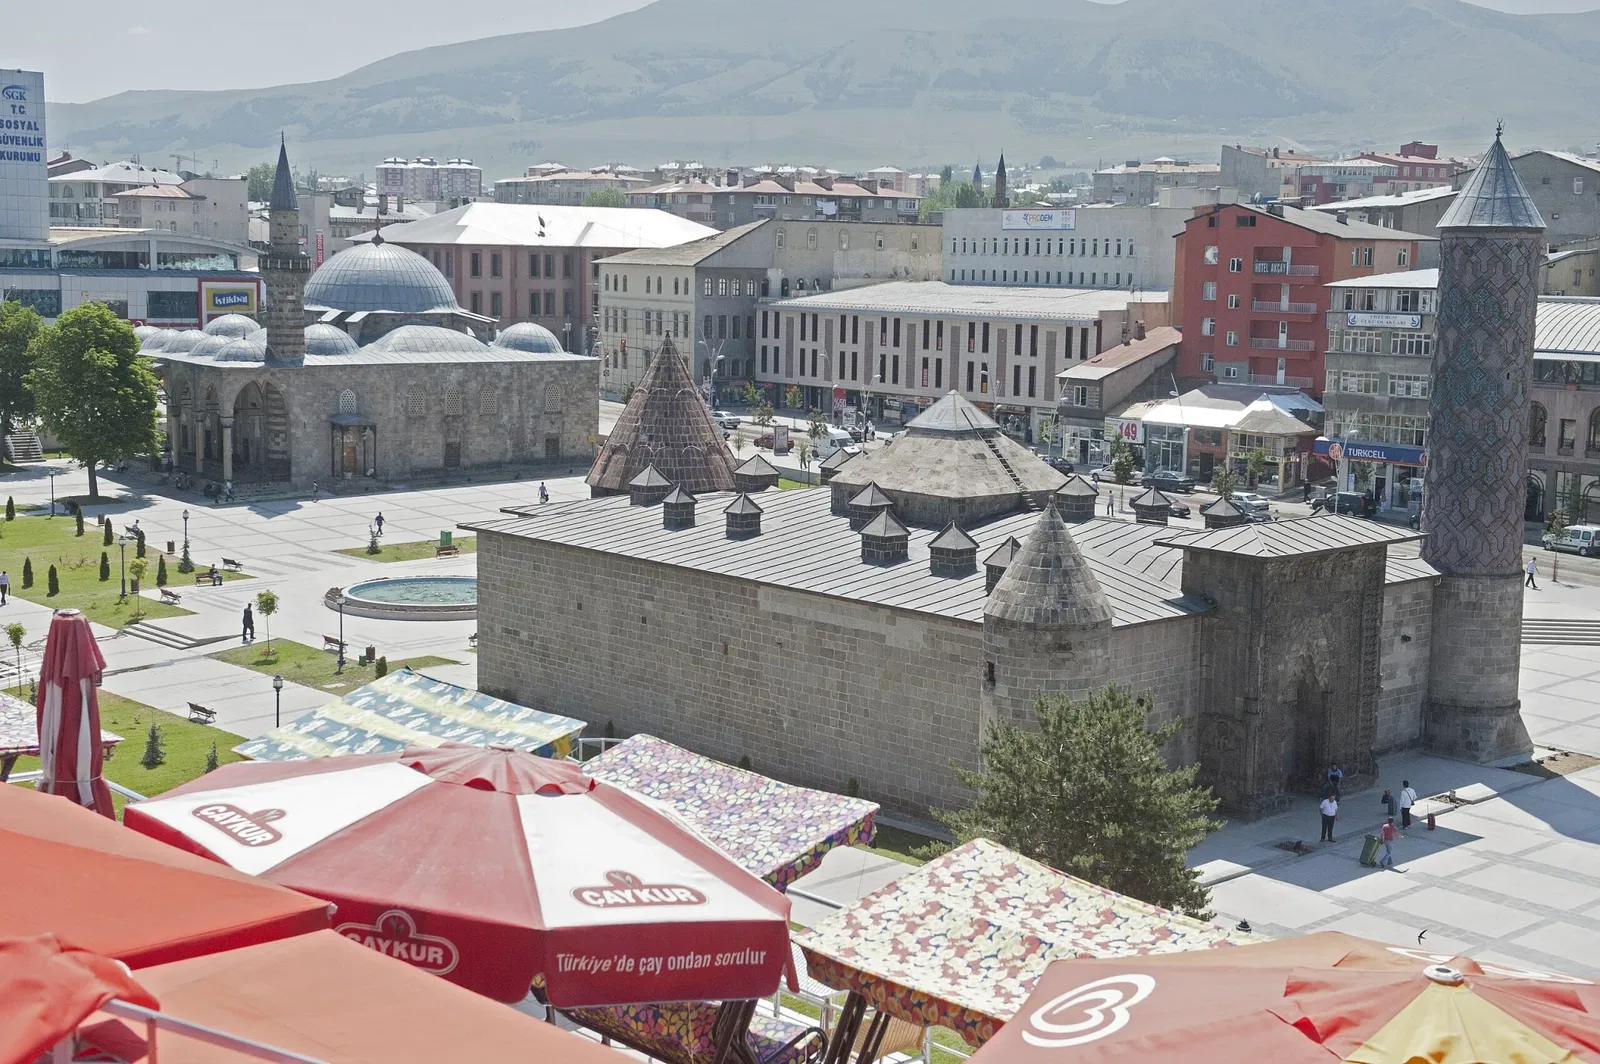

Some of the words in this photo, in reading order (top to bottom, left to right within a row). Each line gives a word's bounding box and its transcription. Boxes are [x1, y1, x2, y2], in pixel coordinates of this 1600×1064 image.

[5, 90, 27, 101] SGK
[0, 118, 40, 131] SOSYAL
[0, 150, 41, 162] KURUMU
[1254, 262, 1269, 273] HOTEL
[1348, 447, 1387, 460] TURKCELL
[195, 805, 275, 845] ÇAYKUR
[582, 888, 698, 907] ÇAYKUR
[556, 953, 635, 975] Türkiye'de
[639, 956, 664, 976] çay
[667, 951, 712, 971] ondan
[714, 947, 767, 967] sorulur
